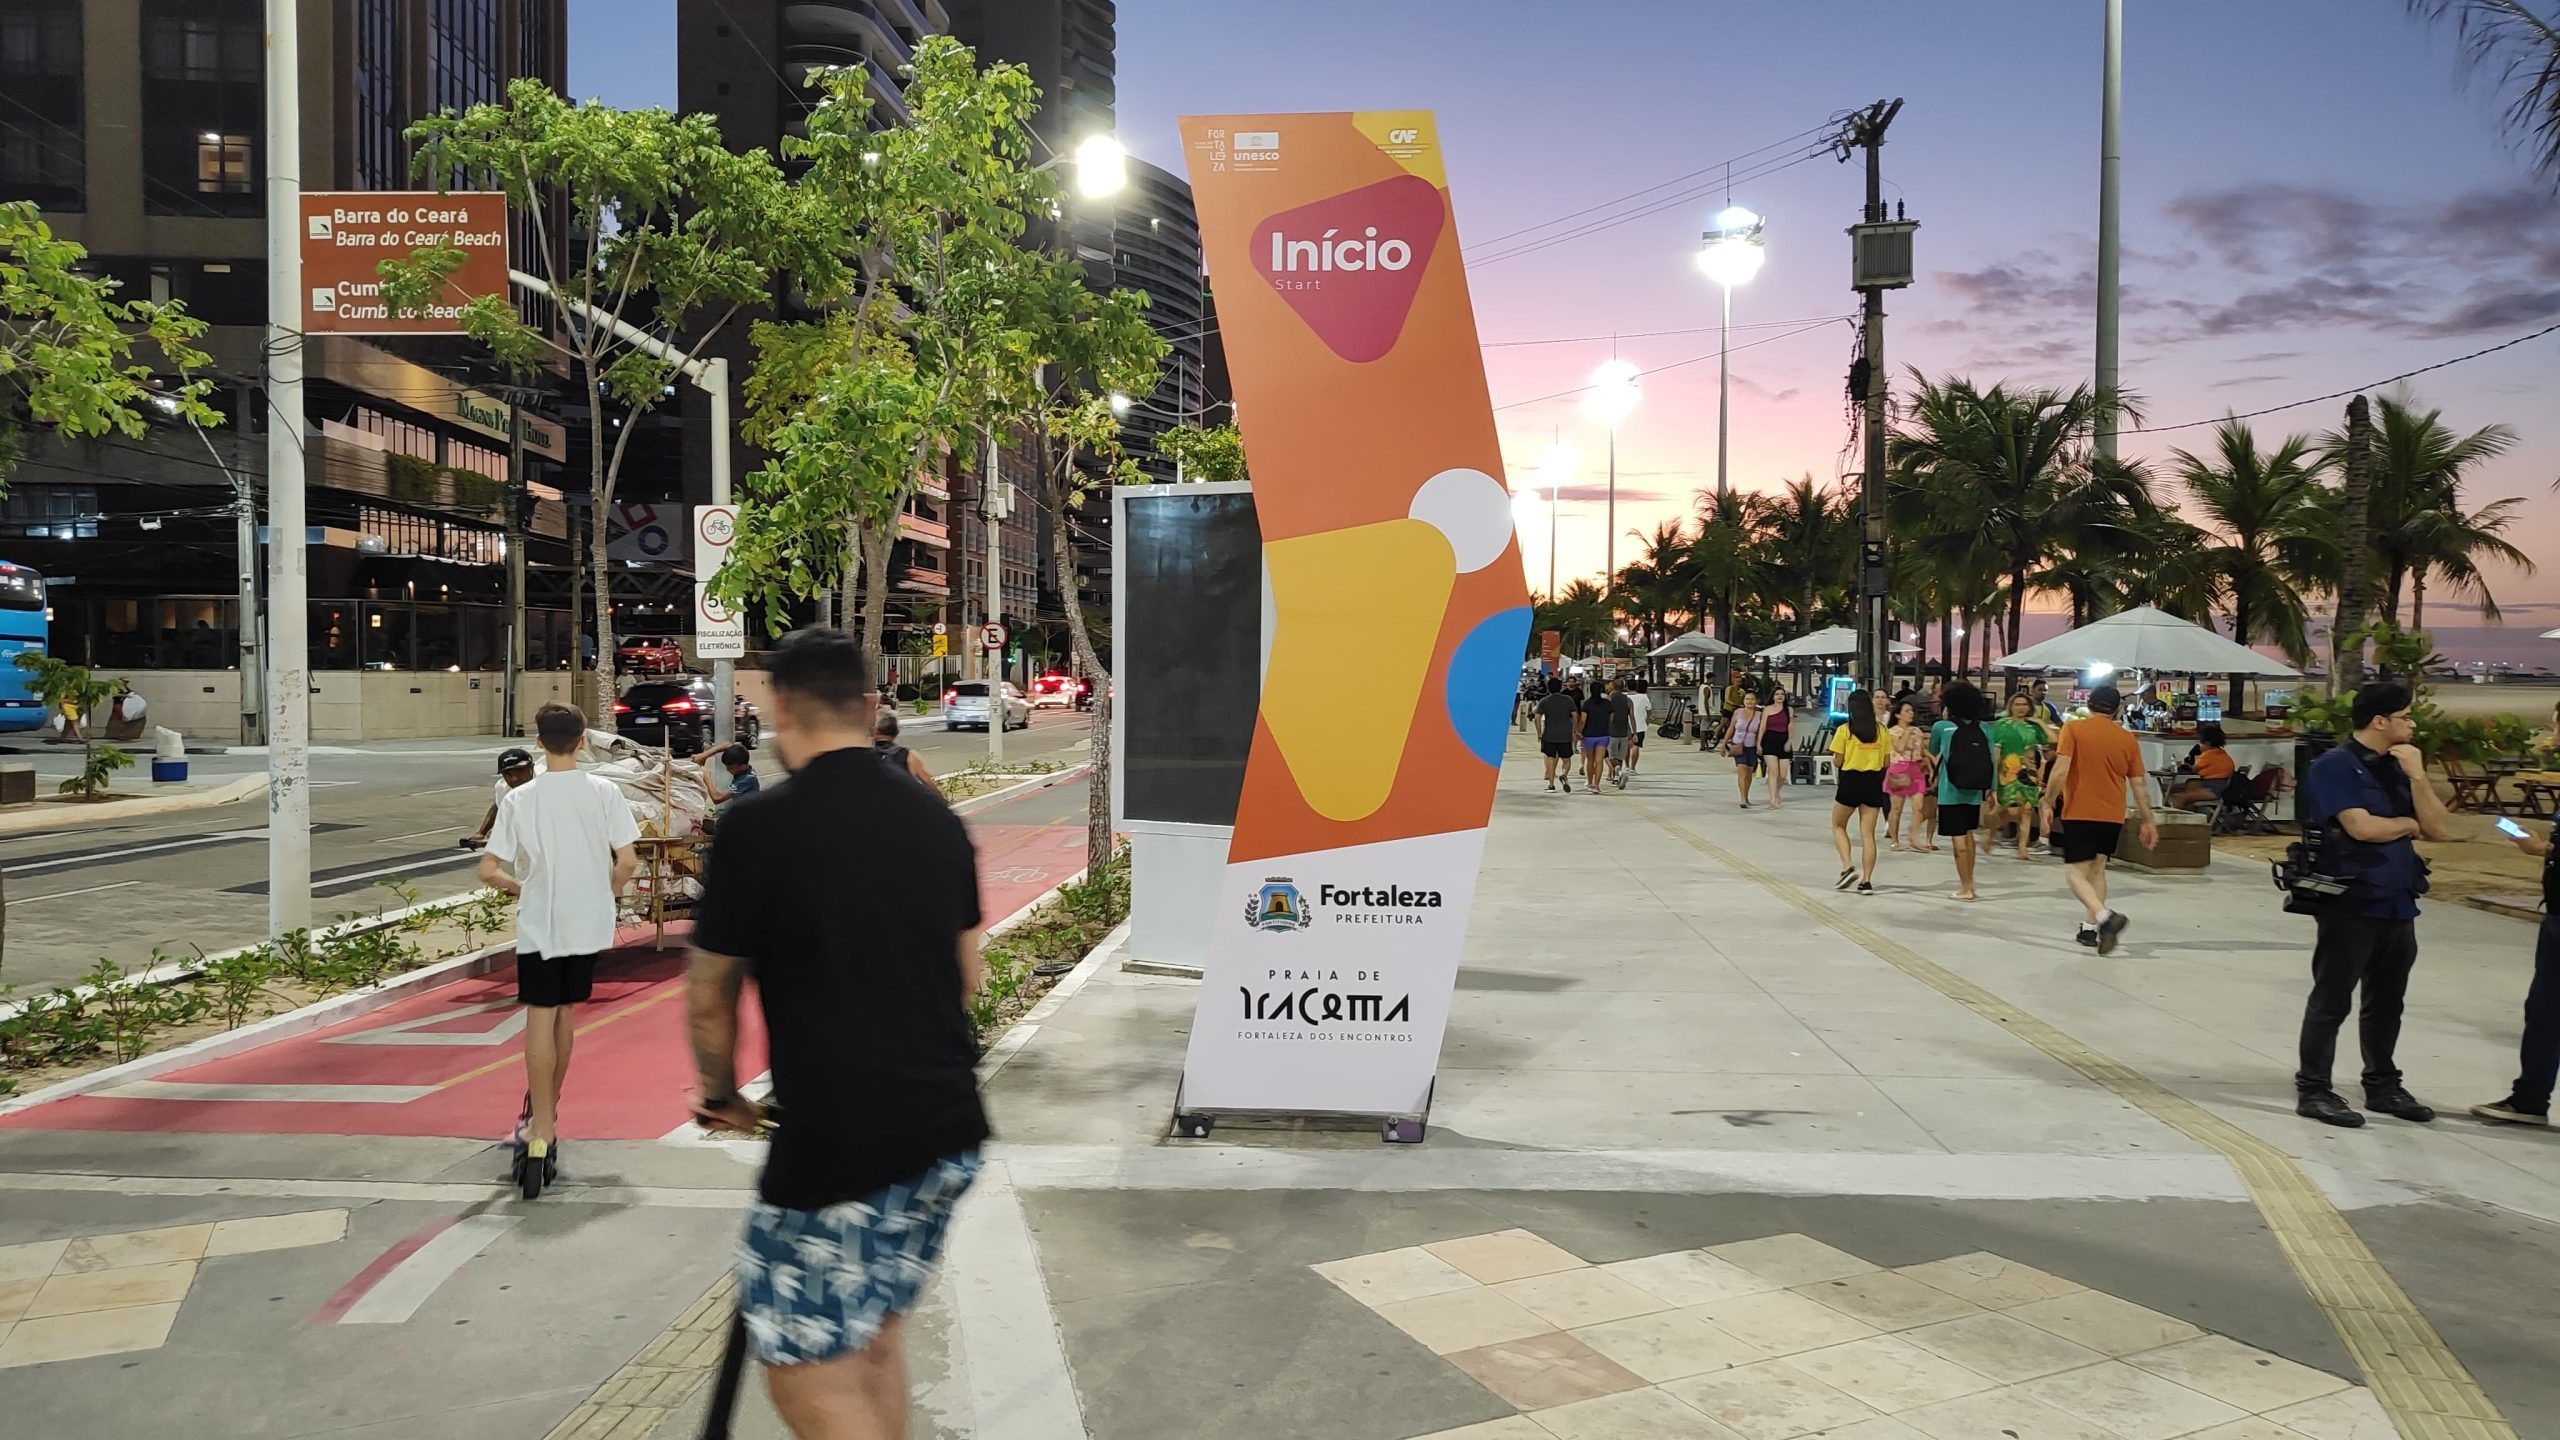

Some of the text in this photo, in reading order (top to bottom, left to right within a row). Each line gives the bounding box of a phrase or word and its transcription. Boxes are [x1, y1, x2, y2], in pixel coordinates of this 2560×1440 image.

[1208, 129, 1225, 139] FOR
[1389, 129, 1418, 144] CAF
[1234, 151, 1280, 161] unesco
[334, 207, 468, 223] Barra do Ceará
[336, 232, 375, 246] Barra
[380, 231, 400, 246] do
[454, 230, 501, 246] Beach
[1271, 226, 1412, 271] Início
[1275, 279, 1321, 290] Start
[339, 303, 418, 319] Cumbco
[697, 629, 743, 638] FISCALIZAÇÃO
[988, 628, 998, 643] E
[699, 642, 741, 650] ELETRÔNICA
[1320, 884, 1442, 908] Fortaleza
[1336, 914, 1423, 924] PREFEITURA
[1269, 969, 1380, 981] PRAIA DE
[1237, 1031, 1413, 1042] FORTALEZA DOS ENCONTROS
